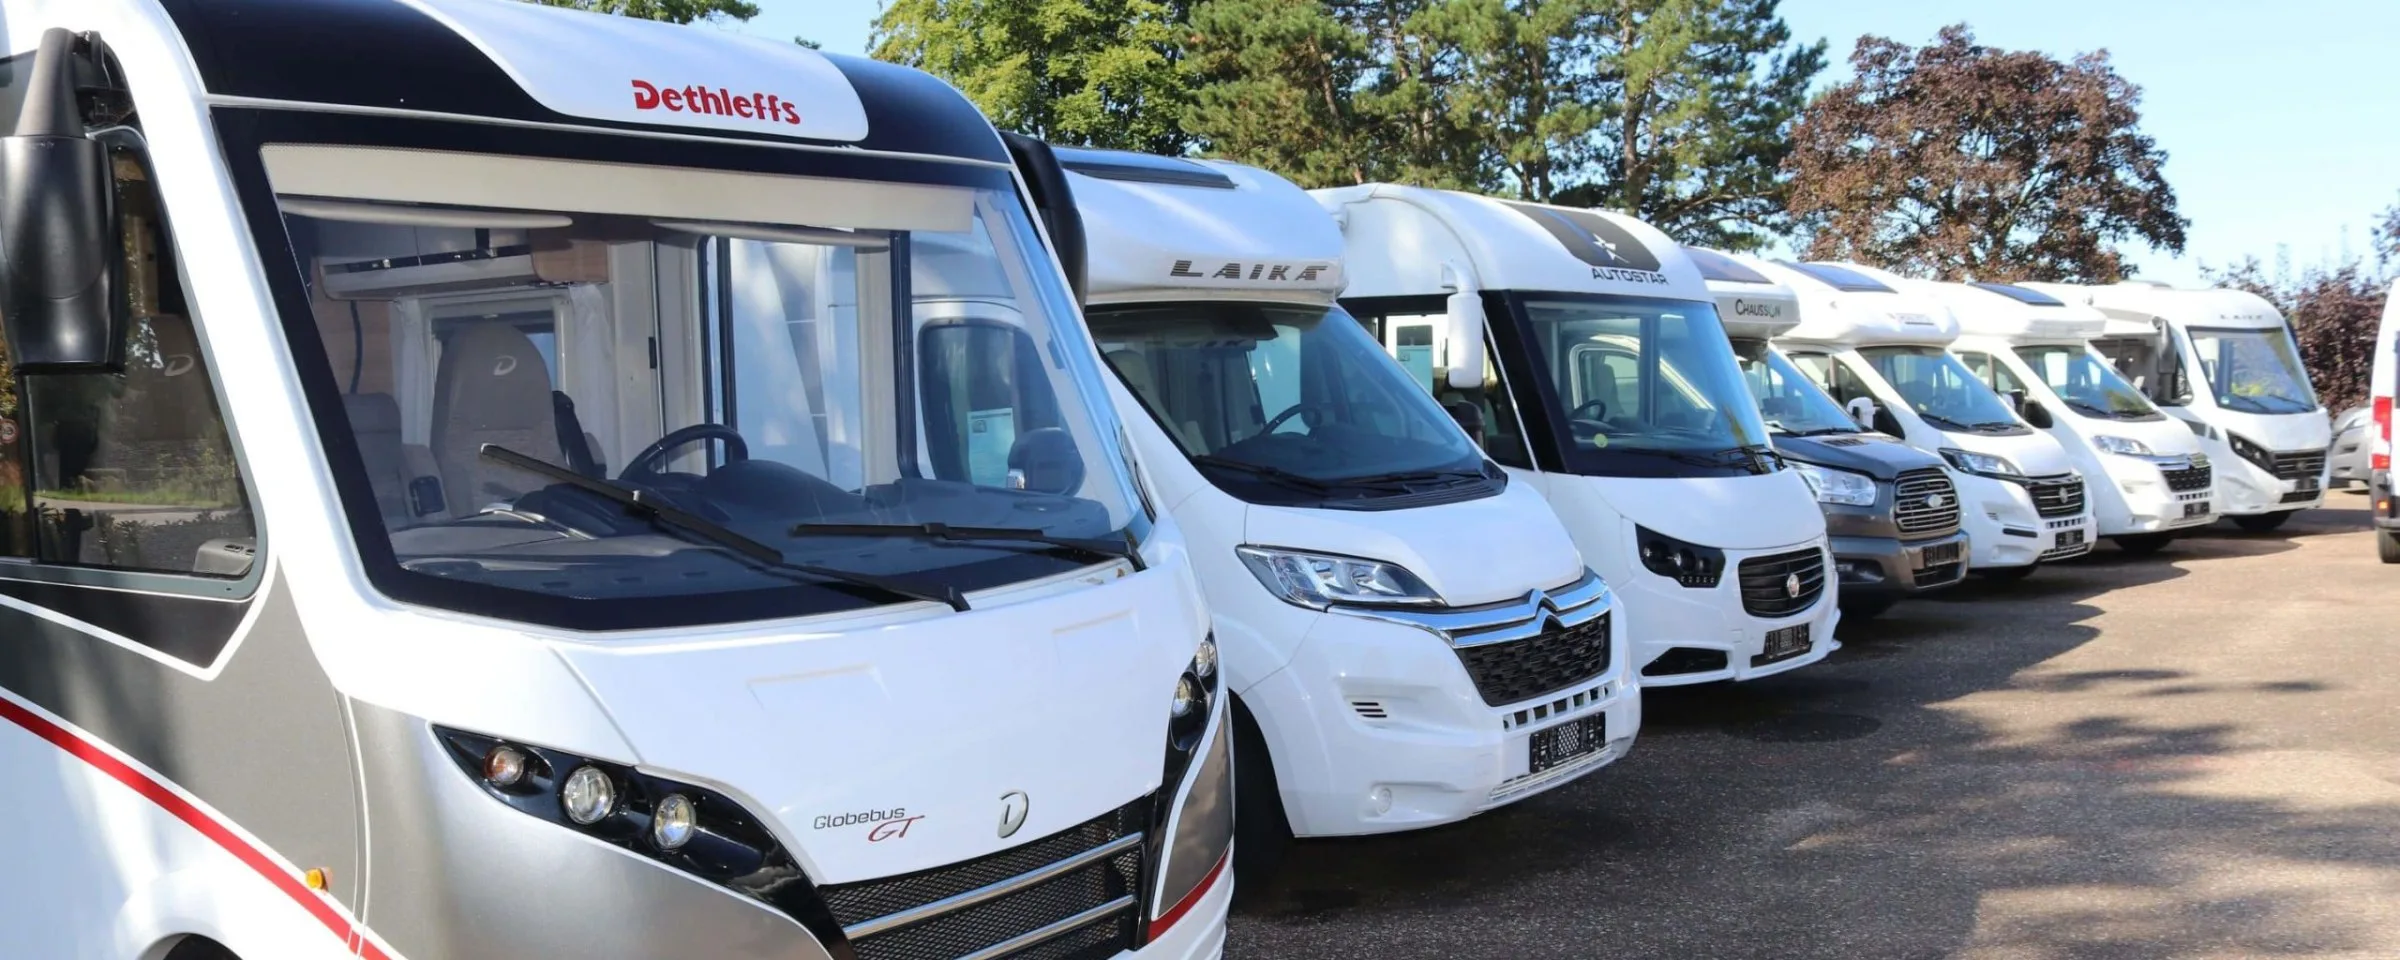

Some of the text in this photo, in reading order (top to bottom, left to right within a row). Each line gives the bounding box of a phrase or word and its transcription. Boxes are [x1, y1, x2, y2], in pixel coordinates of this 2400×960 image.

[631, 79, 801, 125] Dethleffs
[1170, 260, 1328, 281] LAIKA
[1591, 268, 1670, 286] AUTOSTAR
[813, 807, 906, 830] Globebus
[868, 815, 926, 842] GT
